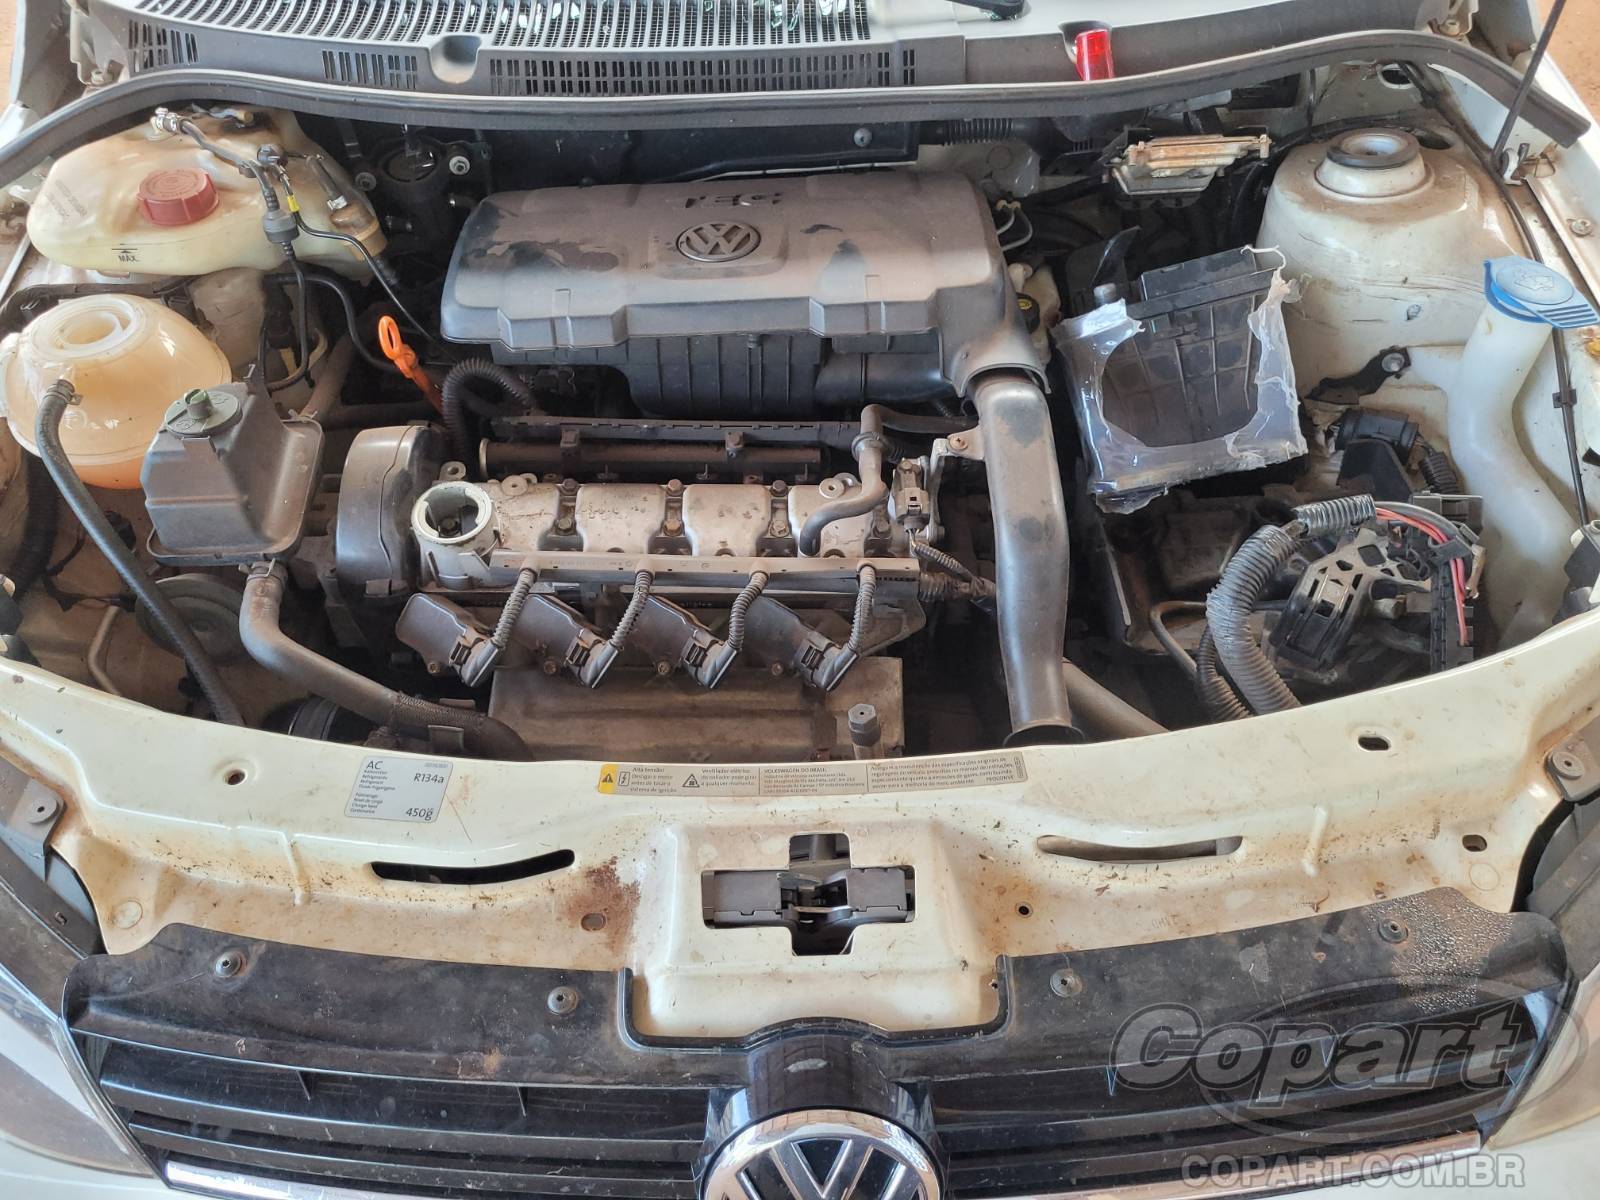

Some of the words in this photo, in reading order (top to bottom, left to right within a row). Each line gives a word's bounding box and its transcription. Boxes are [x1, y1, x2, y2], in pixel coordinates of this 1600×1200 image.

[366, 760, 384, 770] AC
[413, 772, 445, 784] R134a
[405, 807, 433, 821] 450g
